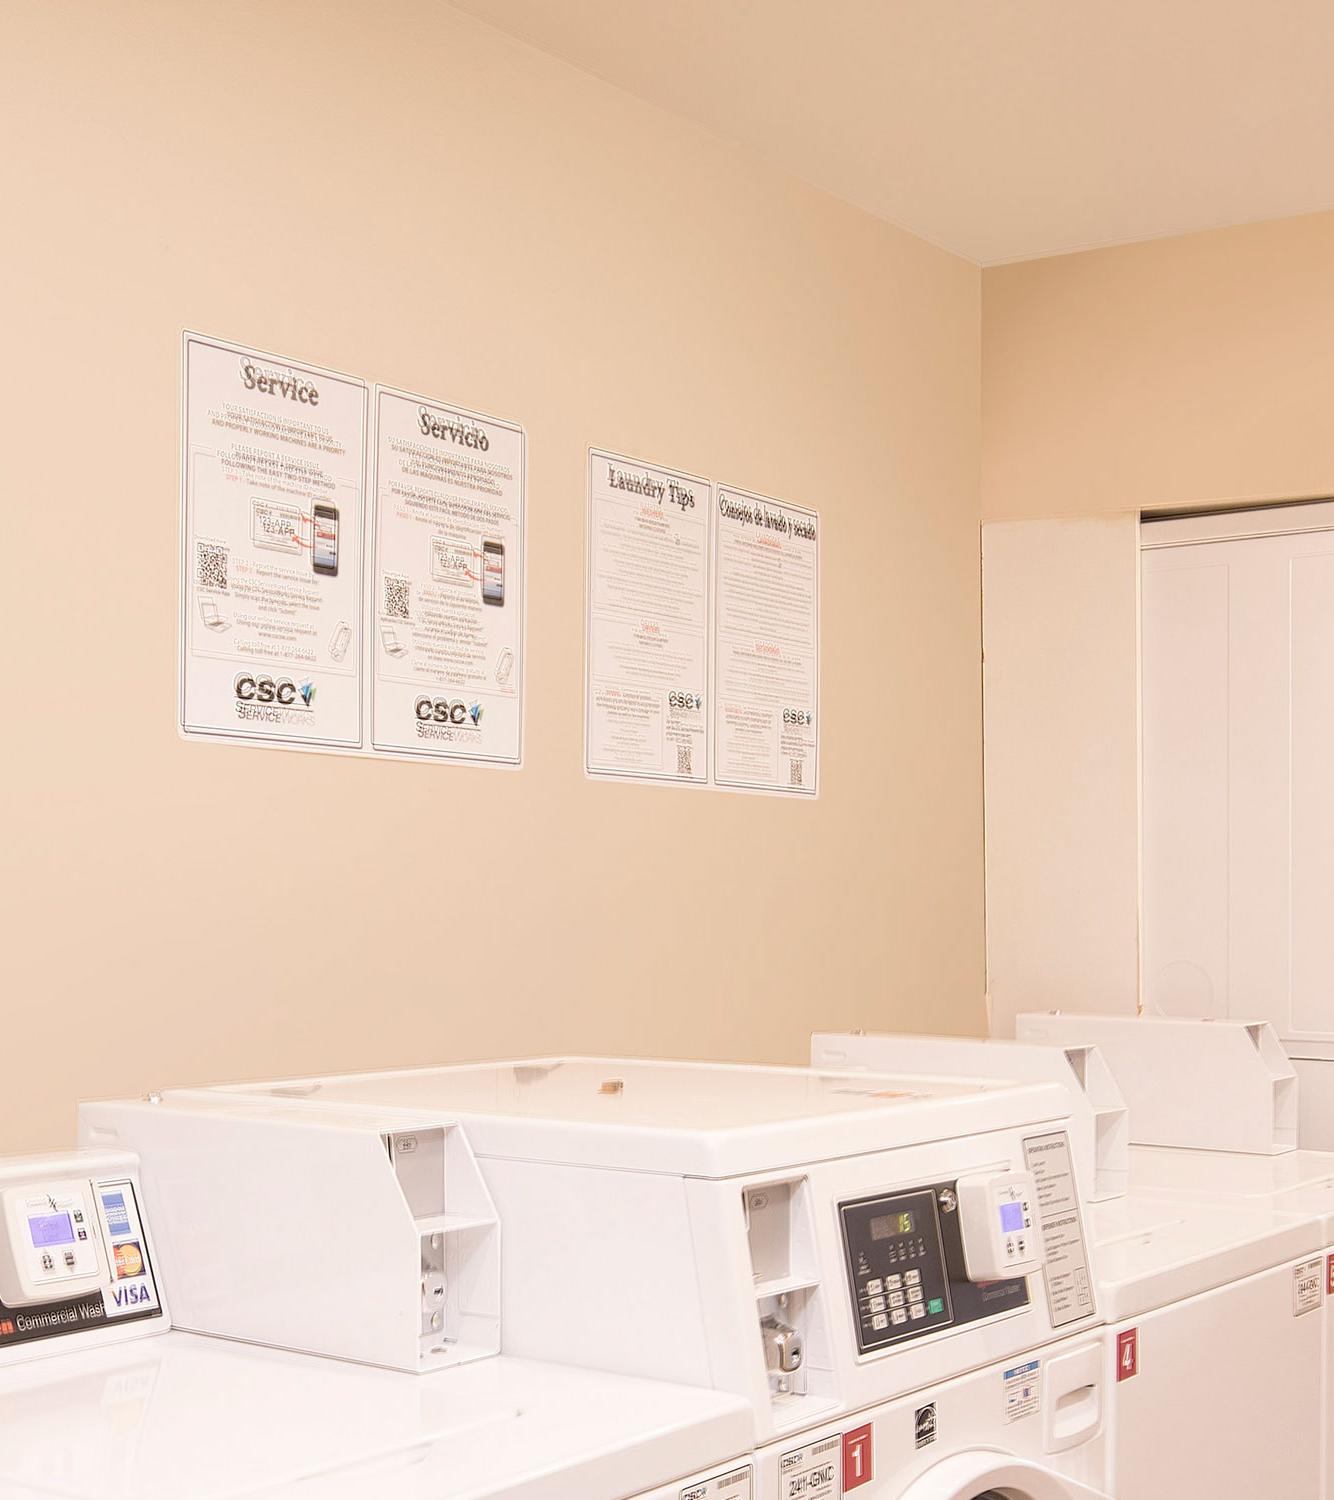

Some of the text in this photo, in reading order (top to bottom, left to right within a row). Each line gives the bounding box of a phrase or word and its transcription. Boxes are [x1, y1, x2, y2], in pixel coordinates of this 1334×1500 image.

[243, 364, 319, 406] Service
[212, 418, 223, 427] AND
[225, 421, 251, 433] PROPERLY
[254, 428, 278, 440] WORKING
[280, 434, 305, 446] MACHINES
[307, 440, 316, 448] ARE
[323, 444, 345, 455] PRIORITY
[420, 411, 489, 451] Servicio
[221, 458, 335, 489] FOLLOWING THE EASY TWO-STEP METHOD
[609, 468, 695, 510] Laundry Tips
[720, 498, 753, 526] Consejos
[764, 510, 787, 532] lavado
[794, 521, 815, 541] secado
[236, 677, 296, 704] CSC
[416, 700, 466, 724] CSC
[898, 1212, 911, 1232] 15
[111, 1284, 150, 1306] VISA
[16, 1307, 77, 1331] Commercial
[1123, 1343, 1135, 1370] 4
[851, 1442, 867, 1478] 1
